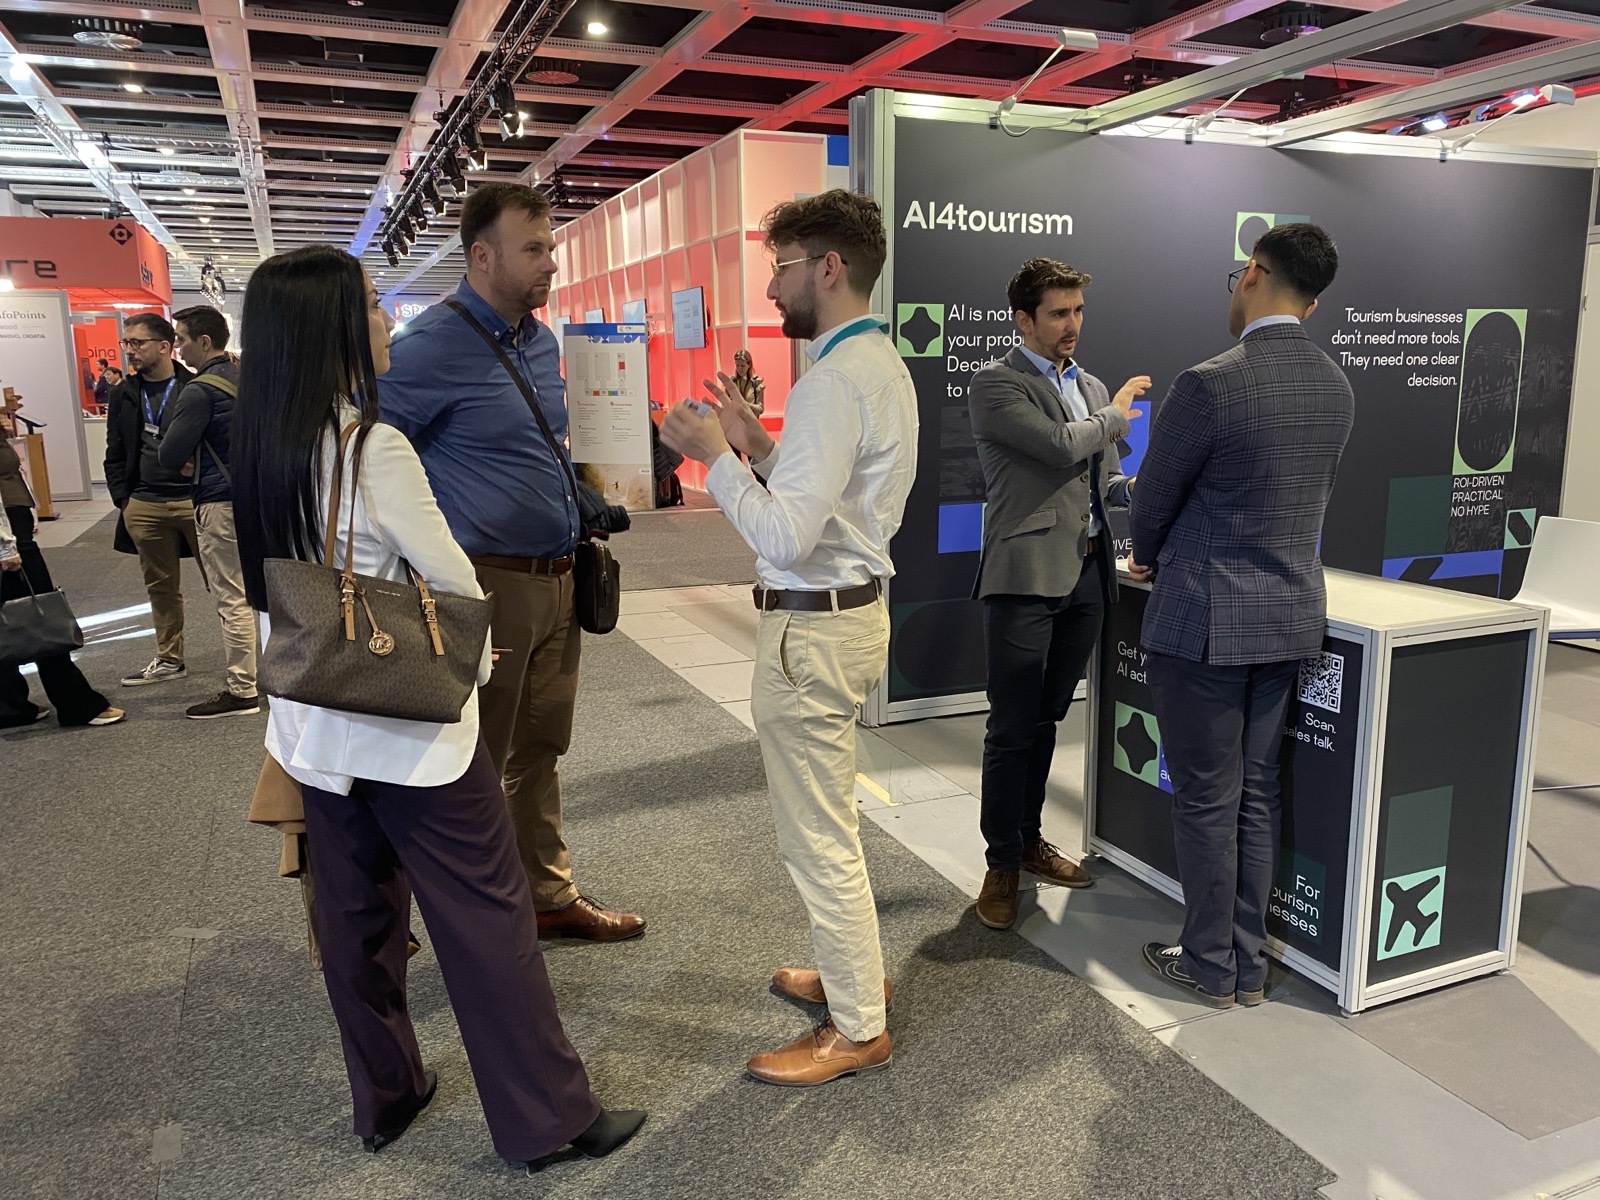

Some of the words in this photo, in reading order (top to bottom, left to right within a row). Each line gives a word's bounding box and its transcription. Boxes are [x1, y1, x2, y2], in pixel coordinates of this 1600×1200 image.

[903, 200, 1073, 235] AI4tourism
[948, 304, 965, 321] AI
[969, 307, 983, 321] is
[987, 306, 1013, 321] not
[1345, 308, 1393, 323] Tourism
[1395, 308, 1463, 323] businesses
[947, 335, 982, 352] your
[1331, 329, 1361, 345] don't
[1364, 329, 1395, 345] need
[1398, 333, 1428, 345] more
[1431, 329, 1461, 344] tools.
[1340, 351, 1371, 371] They
[1373, 351, 1404, 366] need
[1406, 354, 1428, 366] one
[1431, 350, 1460, 366] clear
[1407, 372, 1458, 387] decision.
[946, 382, 963, 397] to
[1453, 475, 1505, 488] ROI-DRIVEN
[1452, 490, 1504, 503] PRACTICAL
[1450, 506, 1465, 517] NO
[1466, 504, 1490, 516] HYPE
[1117, 641, 1137, 660] Get
[1116, 661, 1128, 677] AI
[1305, 712, 1337, 734] Scan.
[1313, 734, 1335, 752] talk.
[1296, 874, 1321, 900] For
